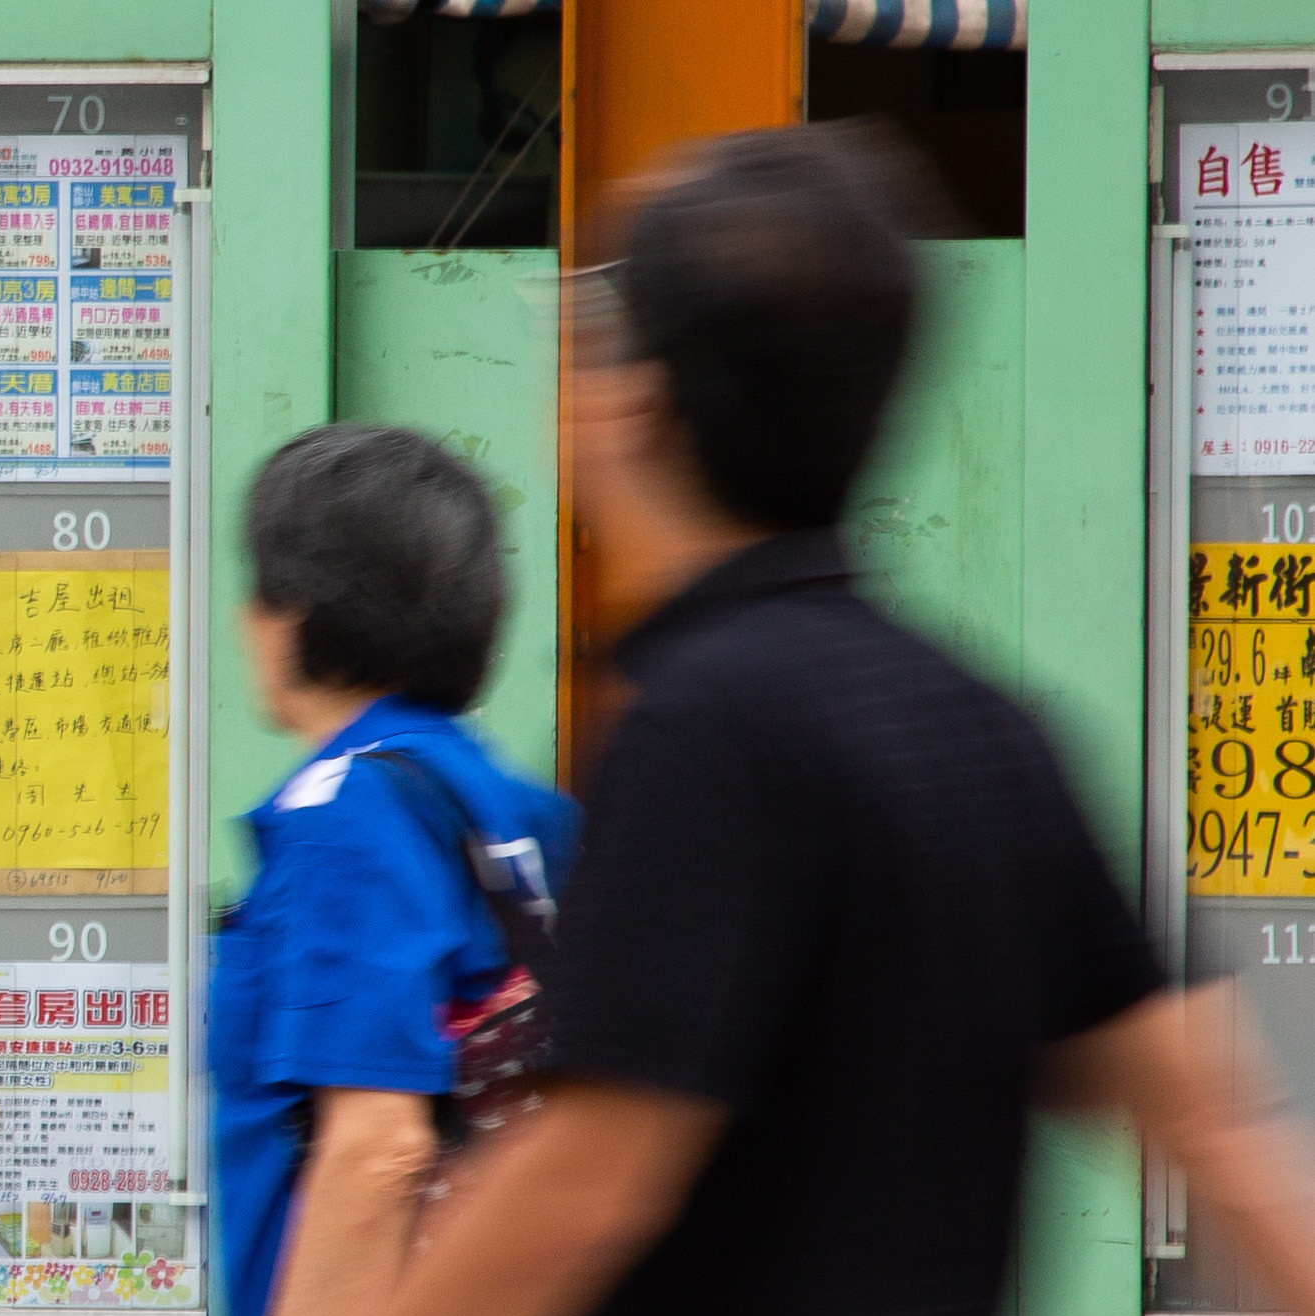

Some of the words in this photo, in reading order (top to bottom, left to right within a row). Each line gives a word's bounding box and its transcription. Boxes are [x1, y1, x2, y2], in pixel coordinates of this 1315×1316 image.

[48, 95, 106, 133] 70
[49, 158, 174, 176] 0932-919-048
[1198, 142, 1285, 198] 自售
[102, 373, 171, 393] 黃金店面
[52, 510, 112, 551] 80
[20, 583, 146, 619] 吉屋出租
[48, 921, 108, 963] 90
